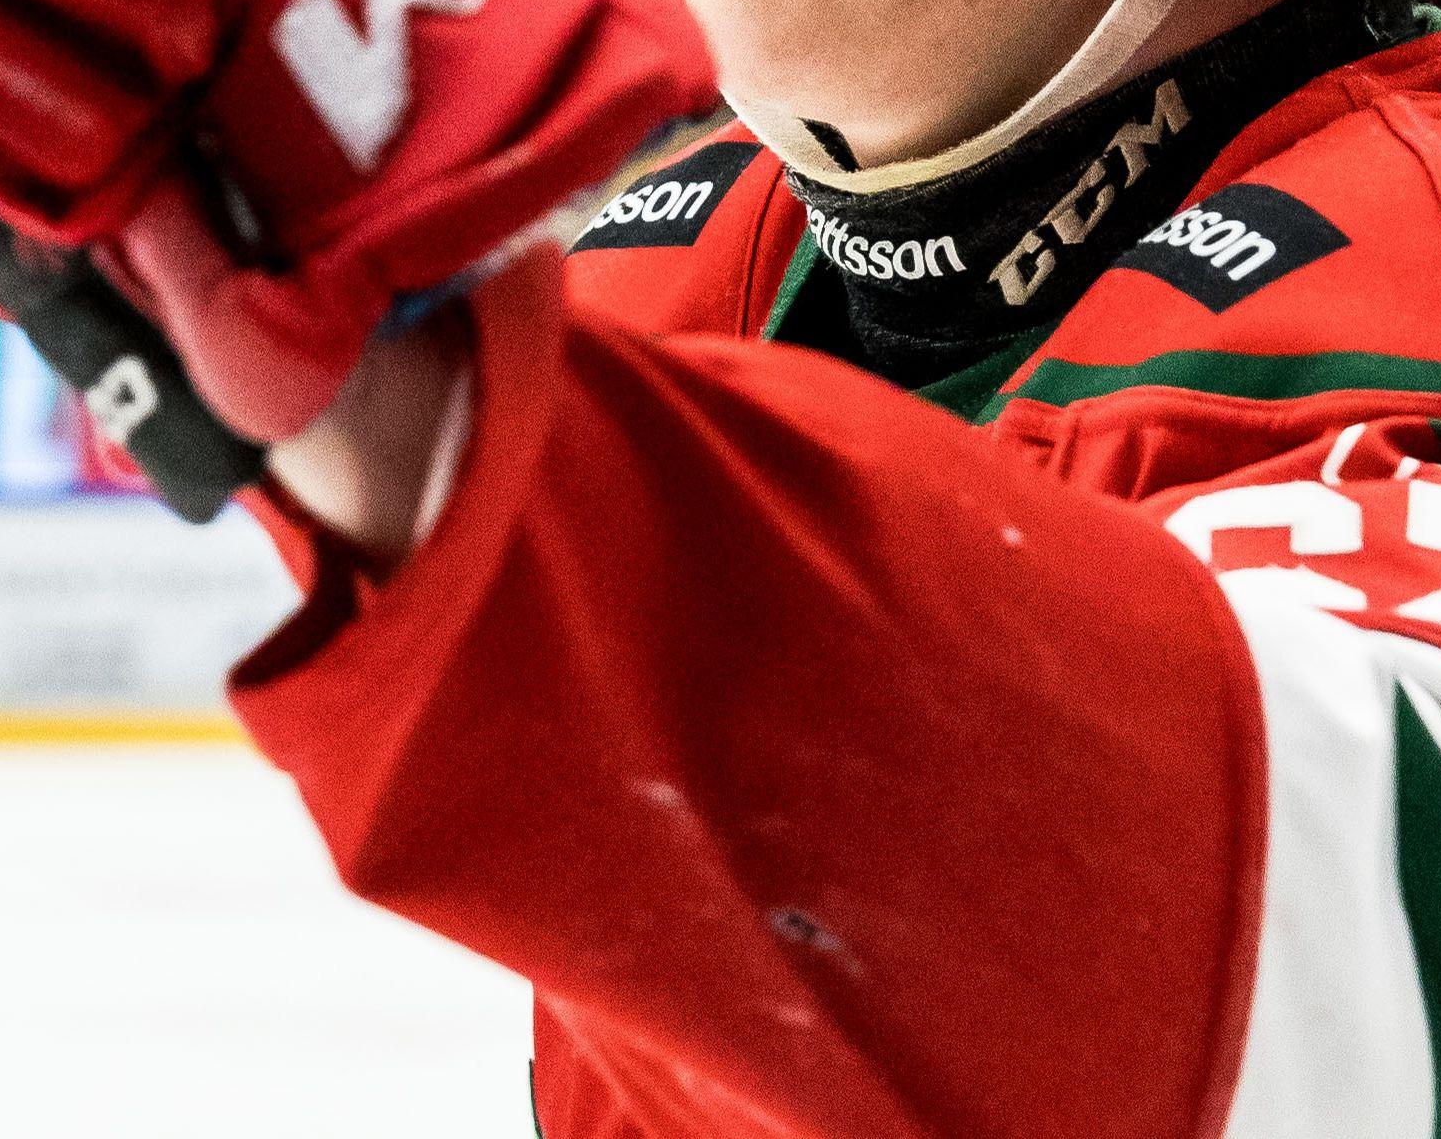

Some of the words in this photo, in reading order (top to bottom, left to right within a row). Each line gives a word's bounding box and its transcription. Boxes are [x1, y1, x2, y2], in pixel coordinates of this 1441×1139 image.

[588, 180, 714, 230] sson
[987, 77, 1192, 307] CCM
[806, 203, 967, 280] attsson
